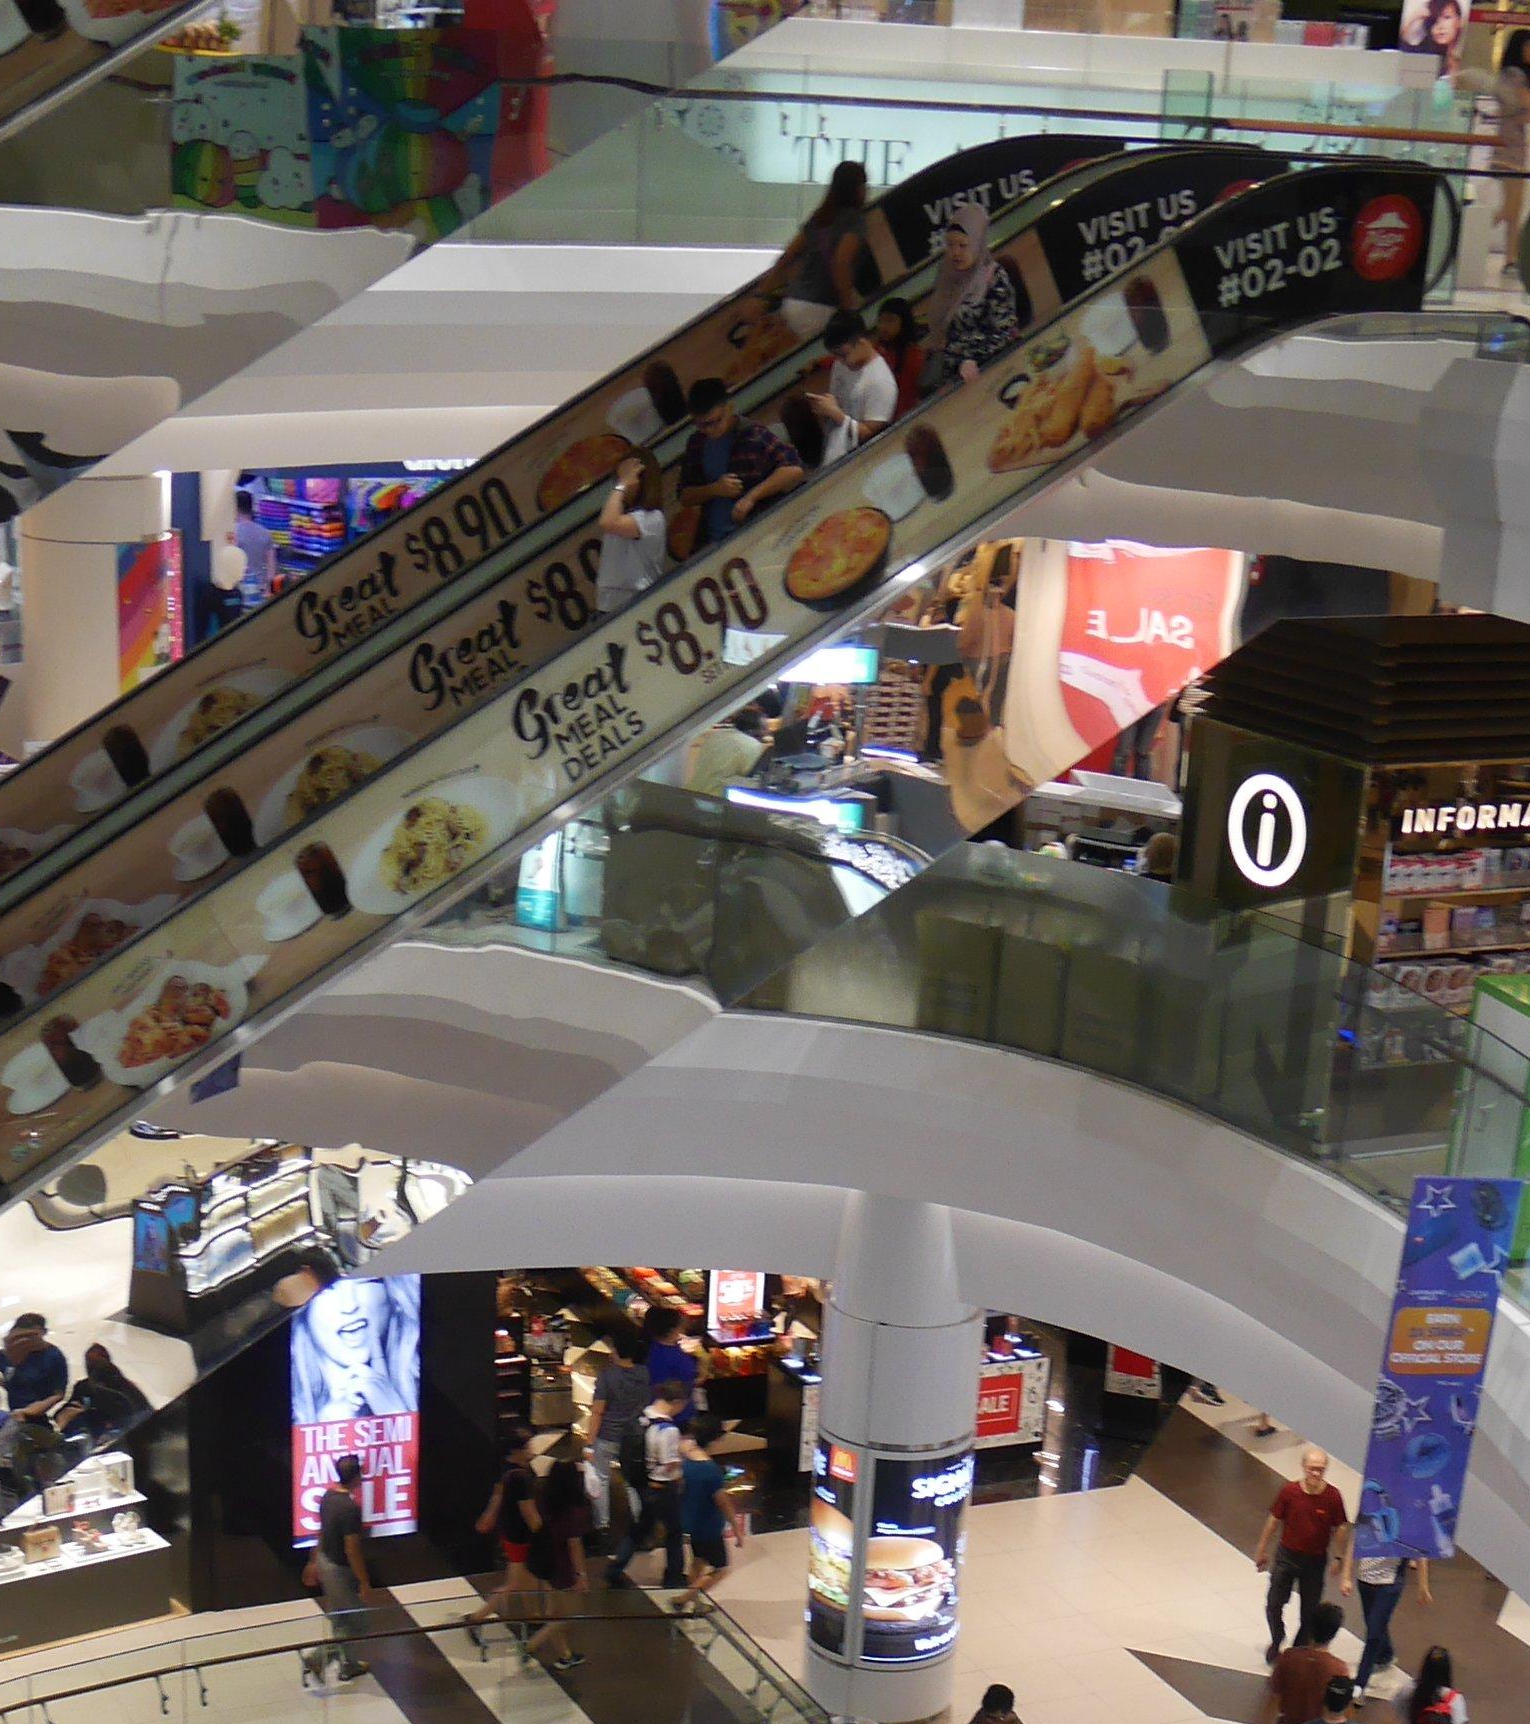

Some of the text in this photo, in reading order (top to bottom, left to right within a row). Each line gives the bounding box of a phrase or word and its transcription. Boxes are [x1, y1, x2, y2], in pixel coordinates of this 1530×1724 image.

[998, 169, 1039, 199] US
[1077, 188, 1197, 248] VISIT US
[1214, 206, 1338, 270] VISIT US
[1218, 238, 1343, 308] #02-02
[295, 551, 402, 656] Great
[333, 600, 399, 653] MEAL
[636, 556, 769, 676] $8.90
[409, 600, 524, 713] Great
[451, 646, 518, 708] MEAL
[512, 642, 631, 760] Great
[552, 694, 628, 756] MEAL
[562, 710, 645, 783] DEALS
[299, 1415, 413, 1454] THE SEMI
[977, 1394, 1011, 1415] ALE
[300, 1445, 411, 1487] ANUAL
[299, 1476, 412, 1531] SLE
